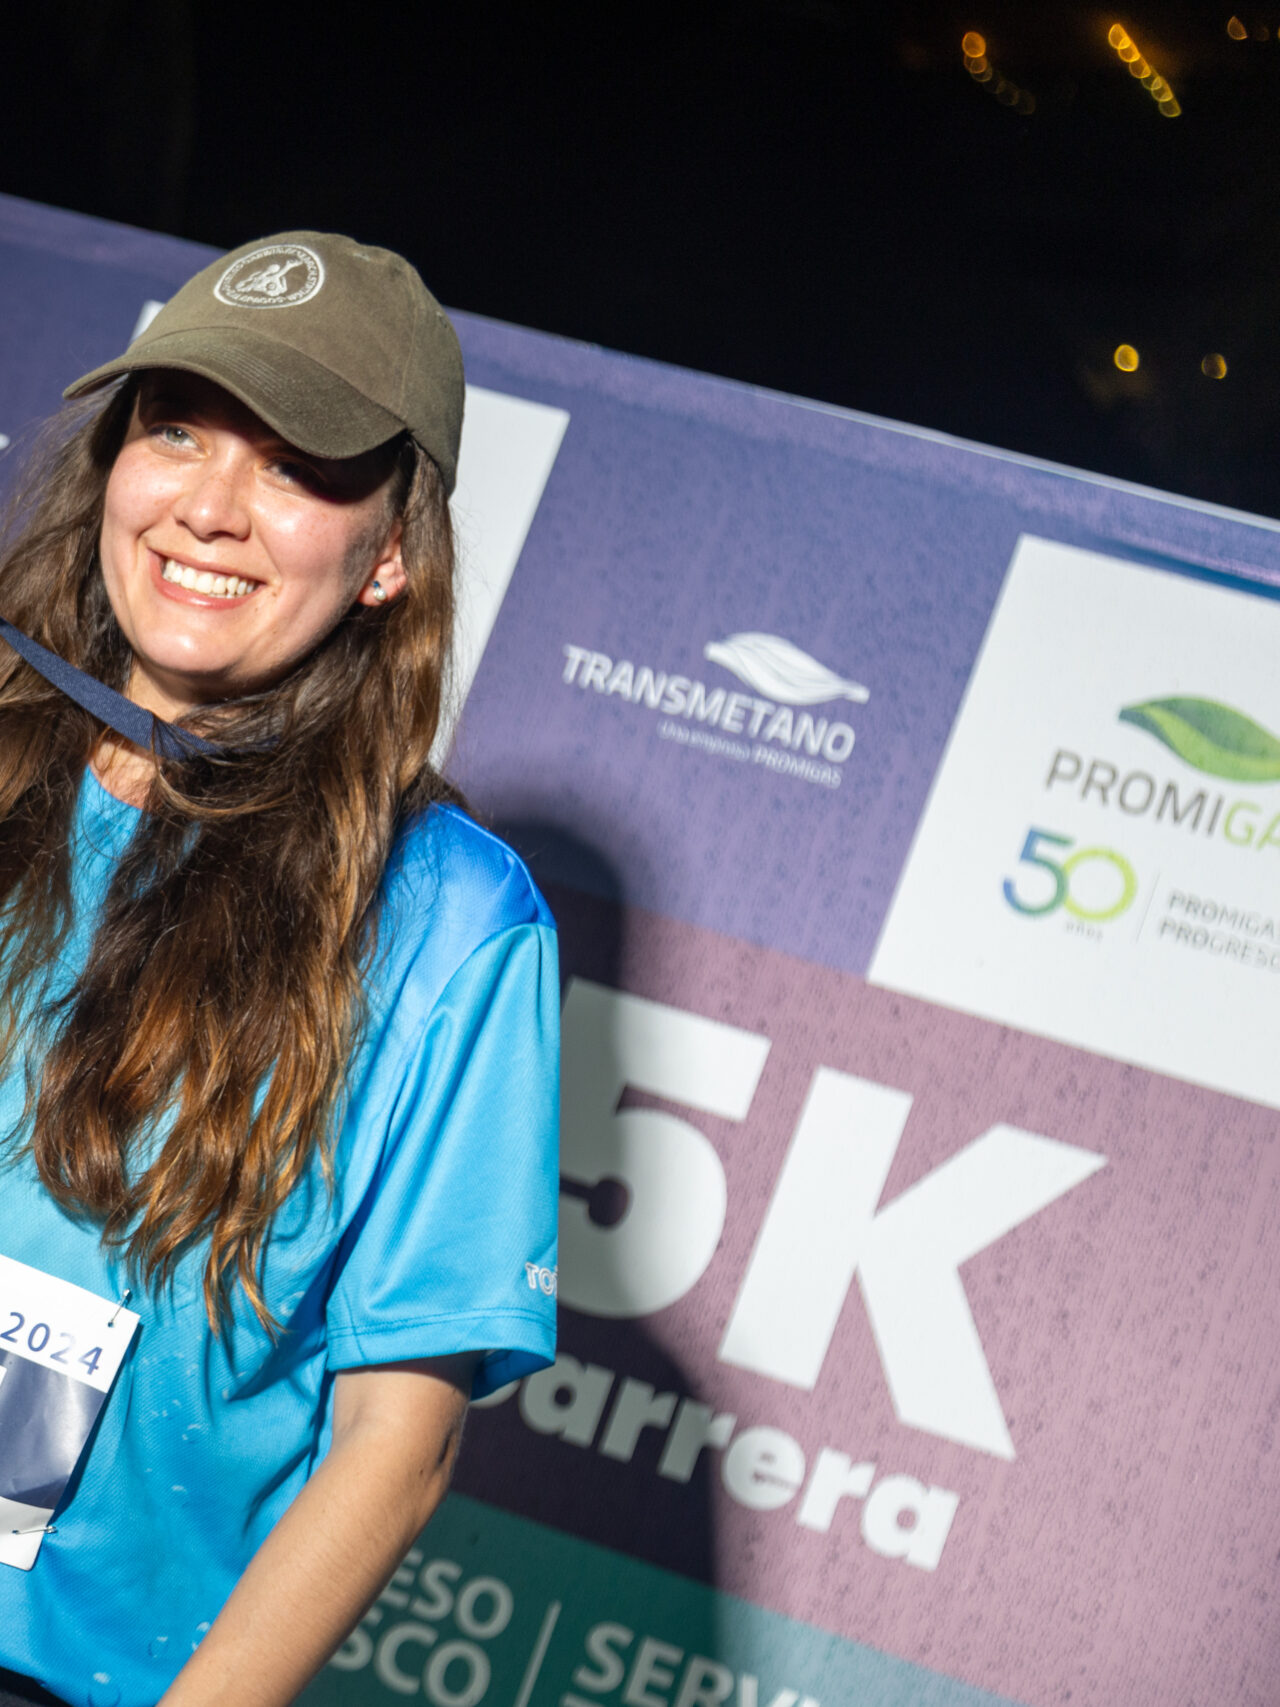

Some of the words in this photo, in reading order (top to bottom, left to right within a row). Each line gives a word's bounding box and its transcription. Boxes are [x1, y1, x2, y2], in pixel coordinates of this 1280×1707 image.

[561, 643, 856, 764] TRANSMETANO
[1002, 823, 1139, 924] 50
[1168, 889, 1280, 945] PROMIGA
[558, 976, 1110, 1462] 5K
[0, 1311, 104, 1376] 2024
[469, 1352, 959, 1572] arrera
